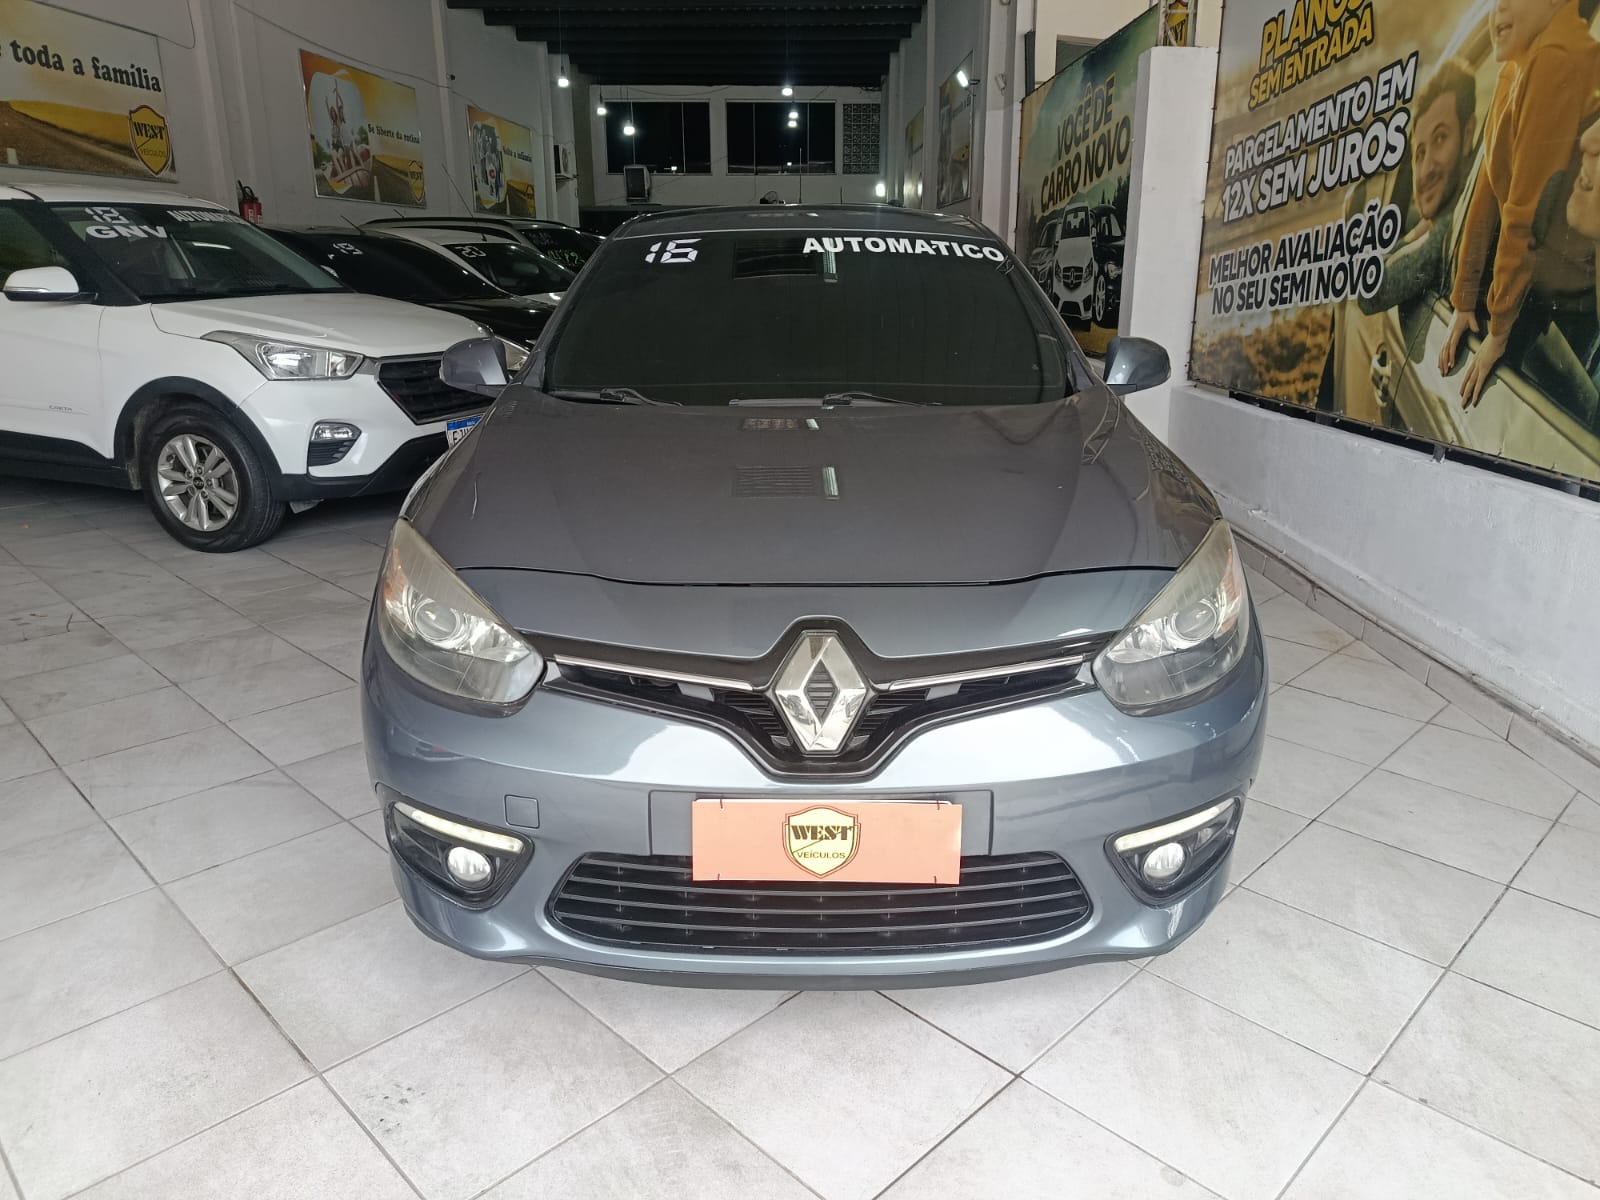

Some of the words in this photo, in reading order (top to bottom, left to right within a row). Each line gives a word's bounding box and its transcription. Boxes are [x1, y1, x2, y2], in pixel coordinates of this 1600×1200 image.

[10, 39, 64, 71] toda
[73, 58, 85, 76] a
[1250, 63, 1282, 108] SEM
[1282, 7, 1373, 89] ENTRADA
[1261, 0, 1365, 68] PLANO
[133, 121, 165, 140] WEST
[1057, 82, 1093, 160] VOCÊ
[1093, 76, 1115, 135] DE
[1225, 79, 1373, 179] PARCELAMENTO
[1375, 53, 1417, 114] EM
[1040, 151, 1082, 213] CARRO
[1083, 116, 1131, 187] NOVO
[1223, 176, 1256, 222] 12X
[1257, 154, 1307, 211] SEM
[1308, 111, 1409, 194] JUROS
[86, 225, 168, 239] GNV
[645, 238, 702, 263] 16
[1209, 243, 1272, 286] MELHOR
[1274, 202, 1399, 272] AVALIAÇÃO
[1212, 284, 1235, 315] NO
[1236, 278, 1267, 313] SEU
[1268, 269, 1313, 307] SEMI
[1314, 256, 1382, 305] NOVO
[791, 825, 853, 840] WEST
[797, 850, 846, 858] VEÍCULOS
